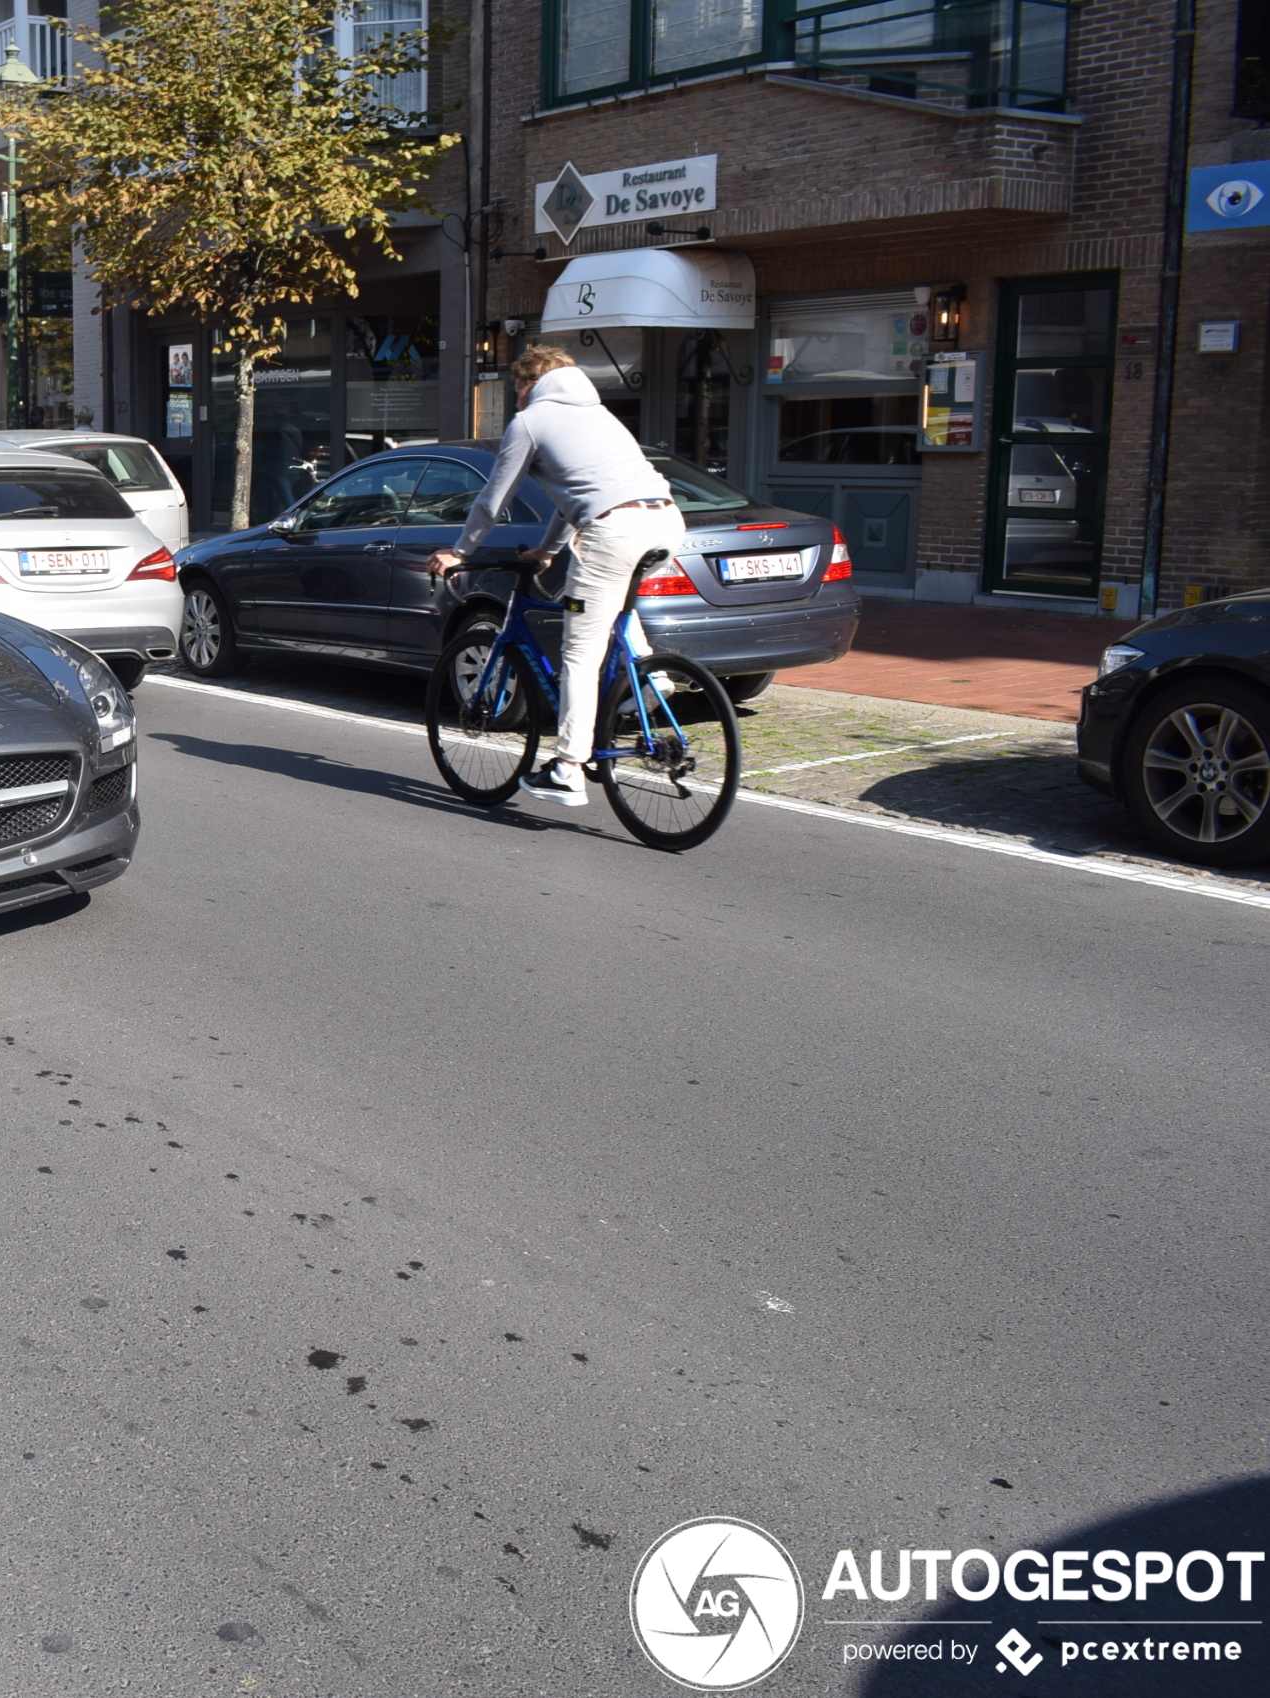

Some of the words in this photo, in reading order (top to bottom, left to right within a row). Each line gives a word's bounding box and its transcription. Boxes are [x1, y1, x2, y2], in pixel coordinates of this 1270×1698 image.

[622, 165, 686, 187] Restaurant
[605, 194, 630, 216] De
[636, 186, 705, 211] Savoye
[710, 280, 743, 289] Restaurant
[701, 289, 715, 303] De
[718, 290, 753, 305] Savoye
[1125, 361, 1142, 380] 18
